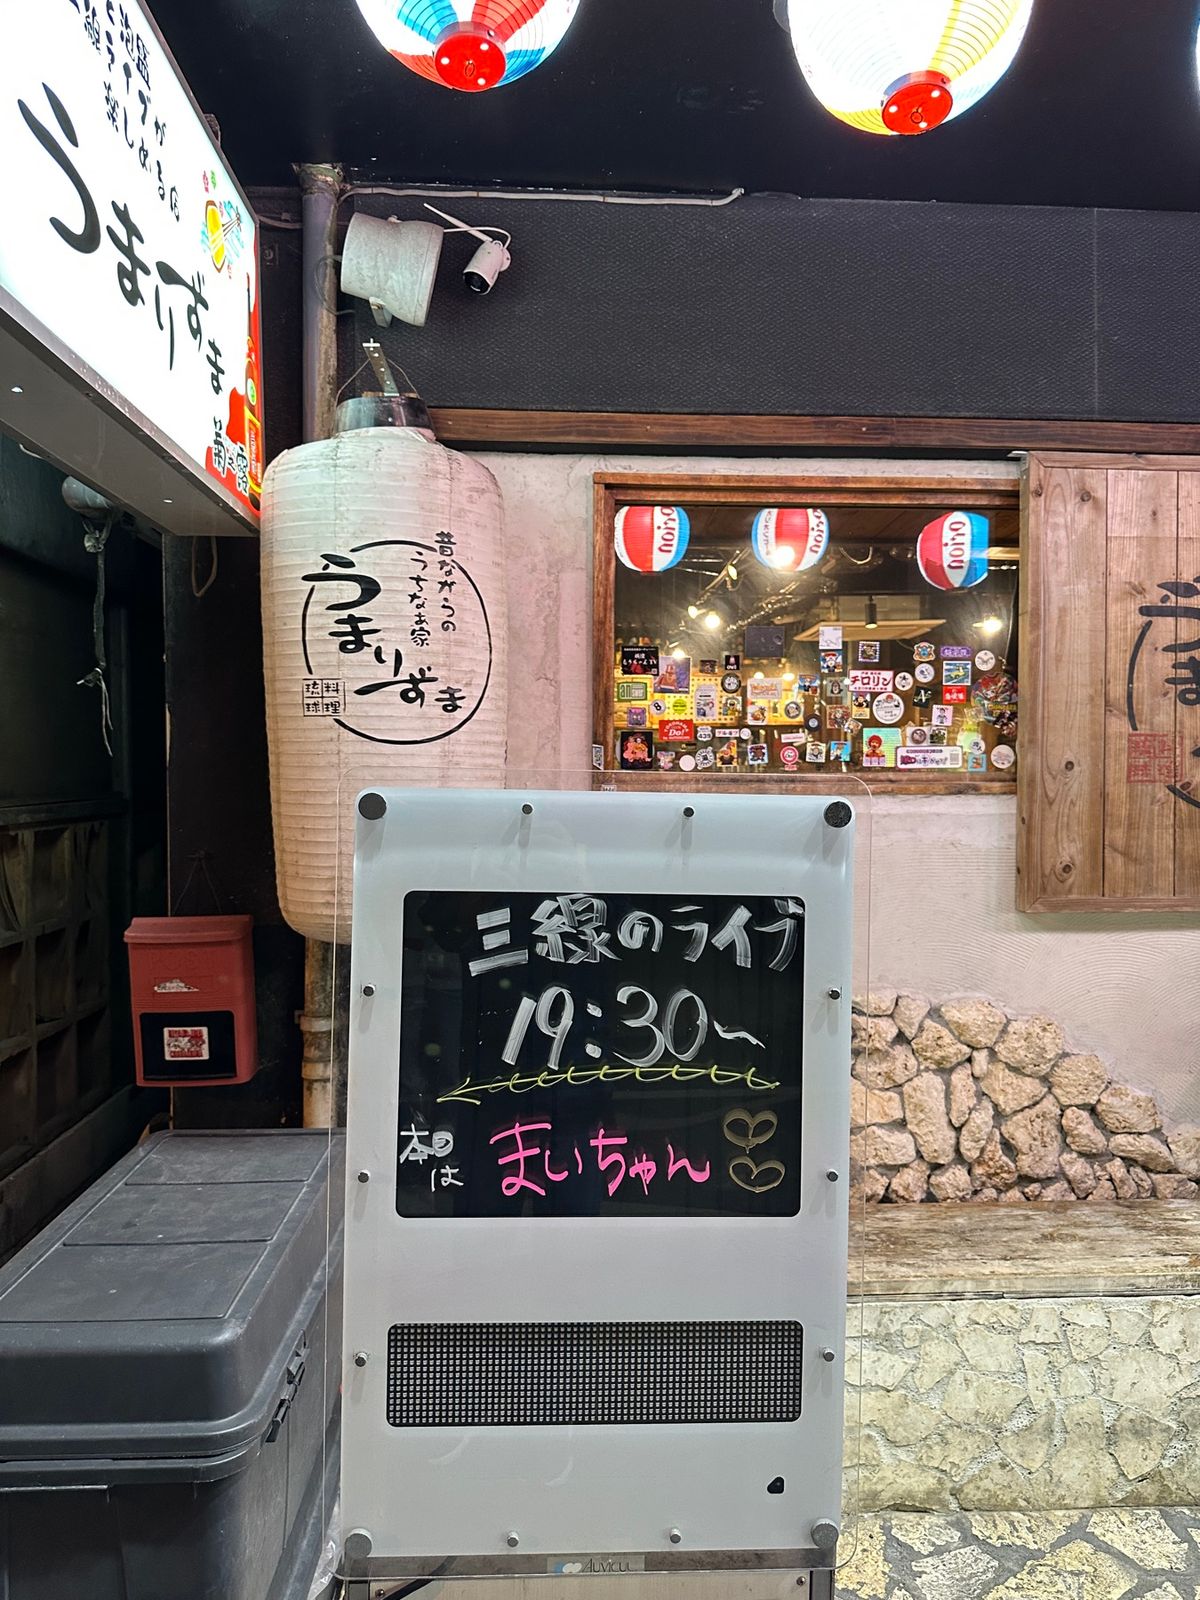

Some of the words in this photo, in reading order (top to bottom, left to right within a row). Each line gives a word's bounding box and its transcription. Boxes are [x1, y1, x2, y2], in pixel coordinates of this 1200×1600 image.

[69, 0, 166, 146] 線ライブが
[103, 81, 179, 222] 楽しめる店
[17, 81, 225, 396] うまりずま
[434, 531, 457, 632] 昔ながらの
[301, 553, 467, 714] うまりずま
[850, 674, 892, 687] チロリン
[1138, 582, 1200, 757] うま
[468, 893, 805, 977] 三線のライブ
[399, 1122, 454, 1165] 本日
[430, 1165, 465, 1192] は
[489, 1122, 712, 1197] まいちゃん
